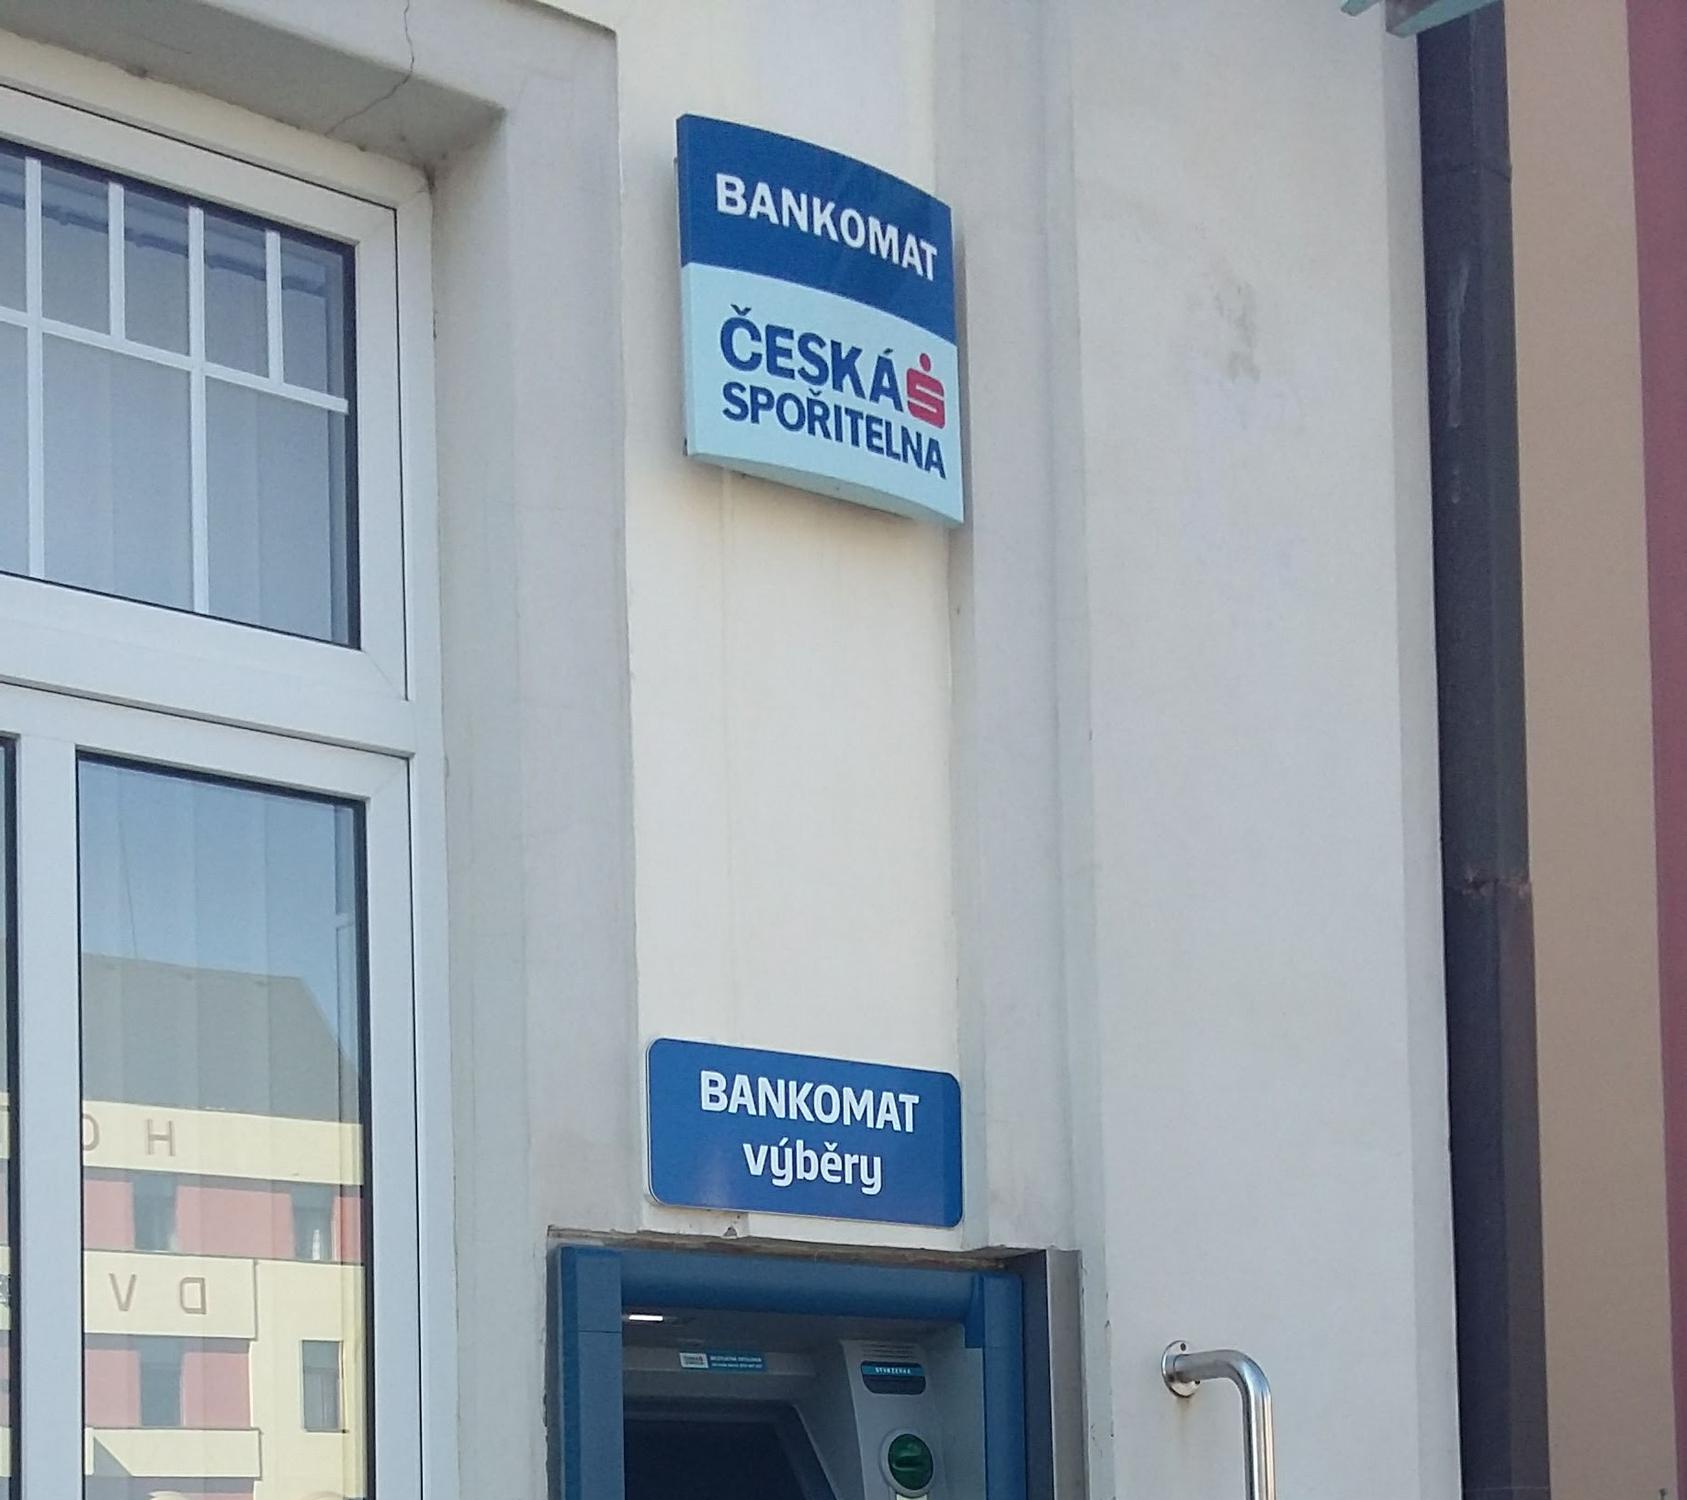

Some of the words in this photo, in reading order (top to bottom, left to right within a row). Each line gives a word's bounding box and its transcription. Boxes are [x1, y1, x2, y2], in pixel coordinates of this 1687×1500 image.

[715, 172, 938, 282] BANKOMAT
[719, 303, 905, 413] ČESKÁ
[722, 381, 947, 481] SPOŘITELNA
[700, 1069, 920, 1134] BANKOMAT
[742, 1136, 883, 1196] výběry
